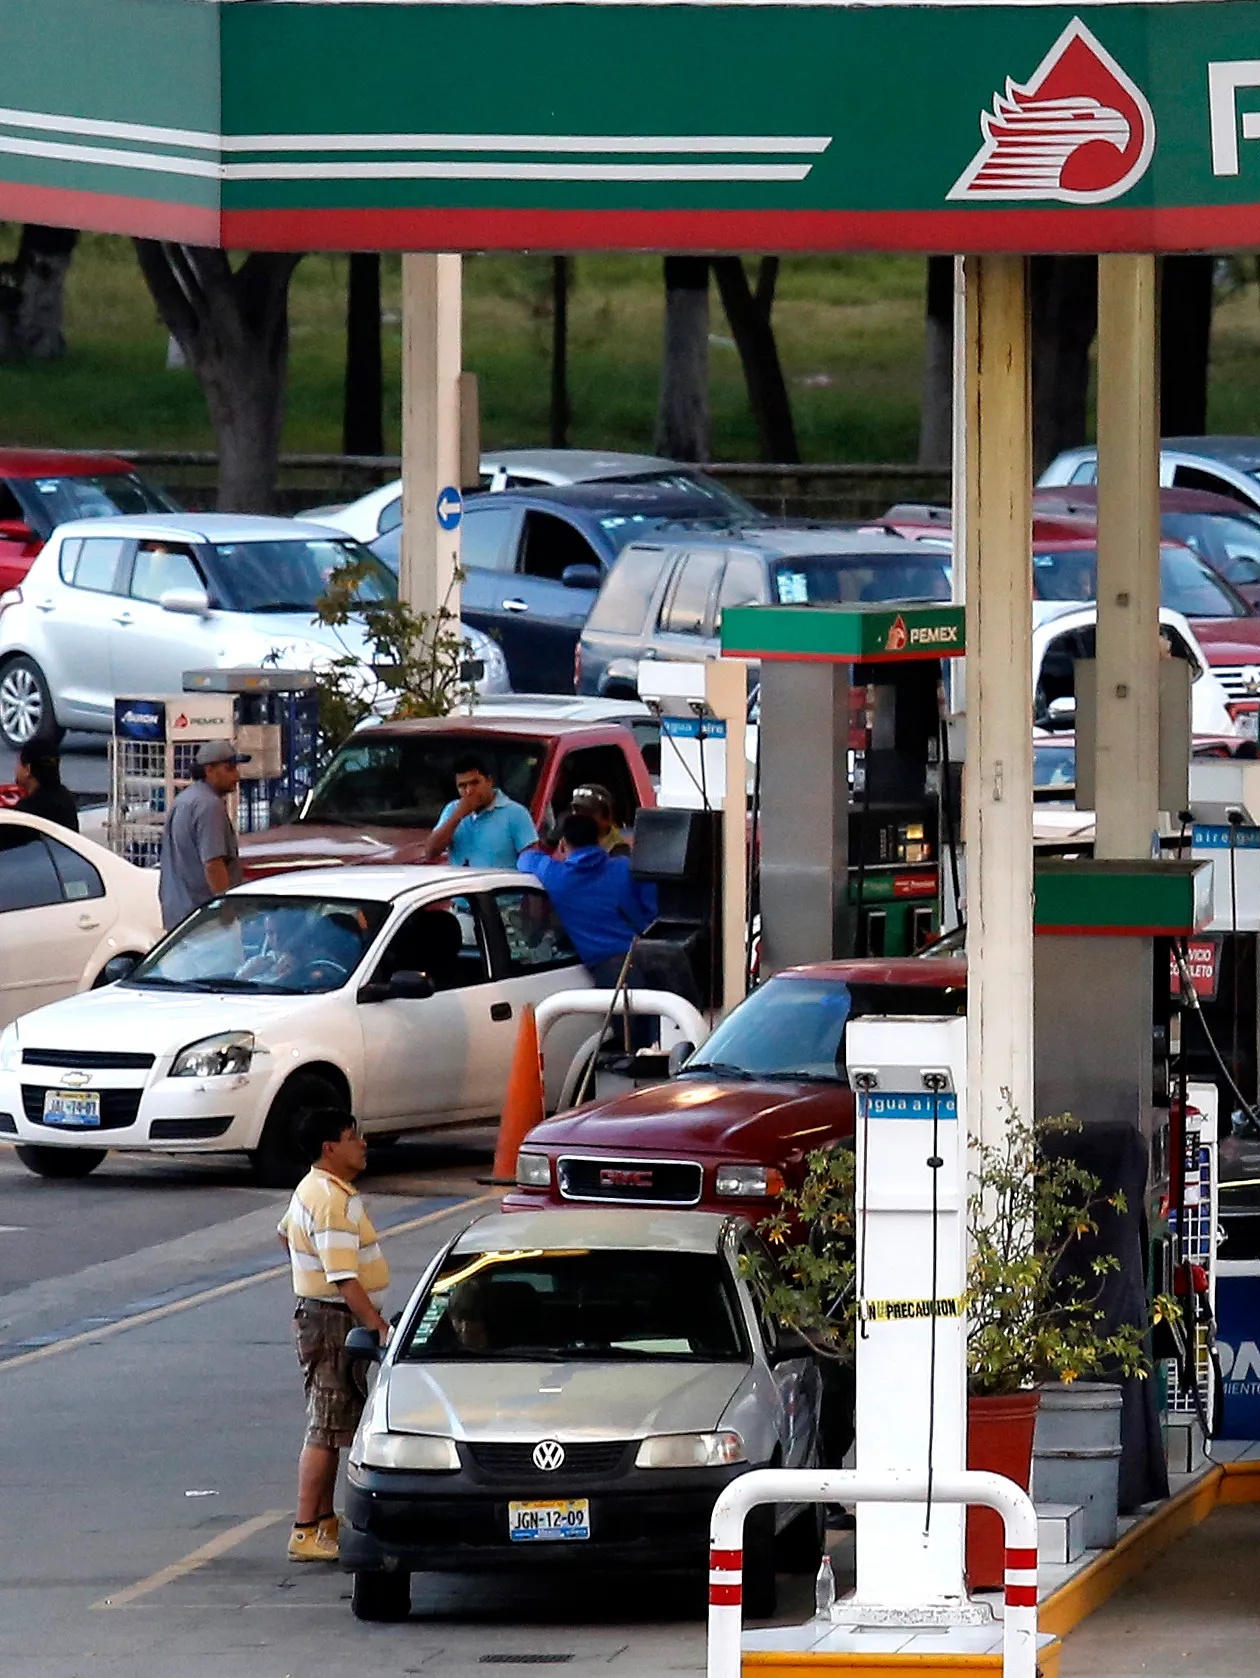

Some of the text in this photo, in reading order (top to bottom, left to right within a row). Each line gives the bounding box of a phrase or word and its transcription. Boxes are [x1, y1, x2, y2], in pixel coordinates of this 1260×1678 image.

[910, 625, 958, 644] PEMEX
[1195, 829, 1229, 844] aire
[1170, 962, 1213, 978] COLETO
[912, 1097, 955, 1111] aire
[600, 1169, 653, 1187] GMC
[886, 1299, 957, 1319] PRECAUION
[514, 1509, 585, 1530] JGN-12-09
